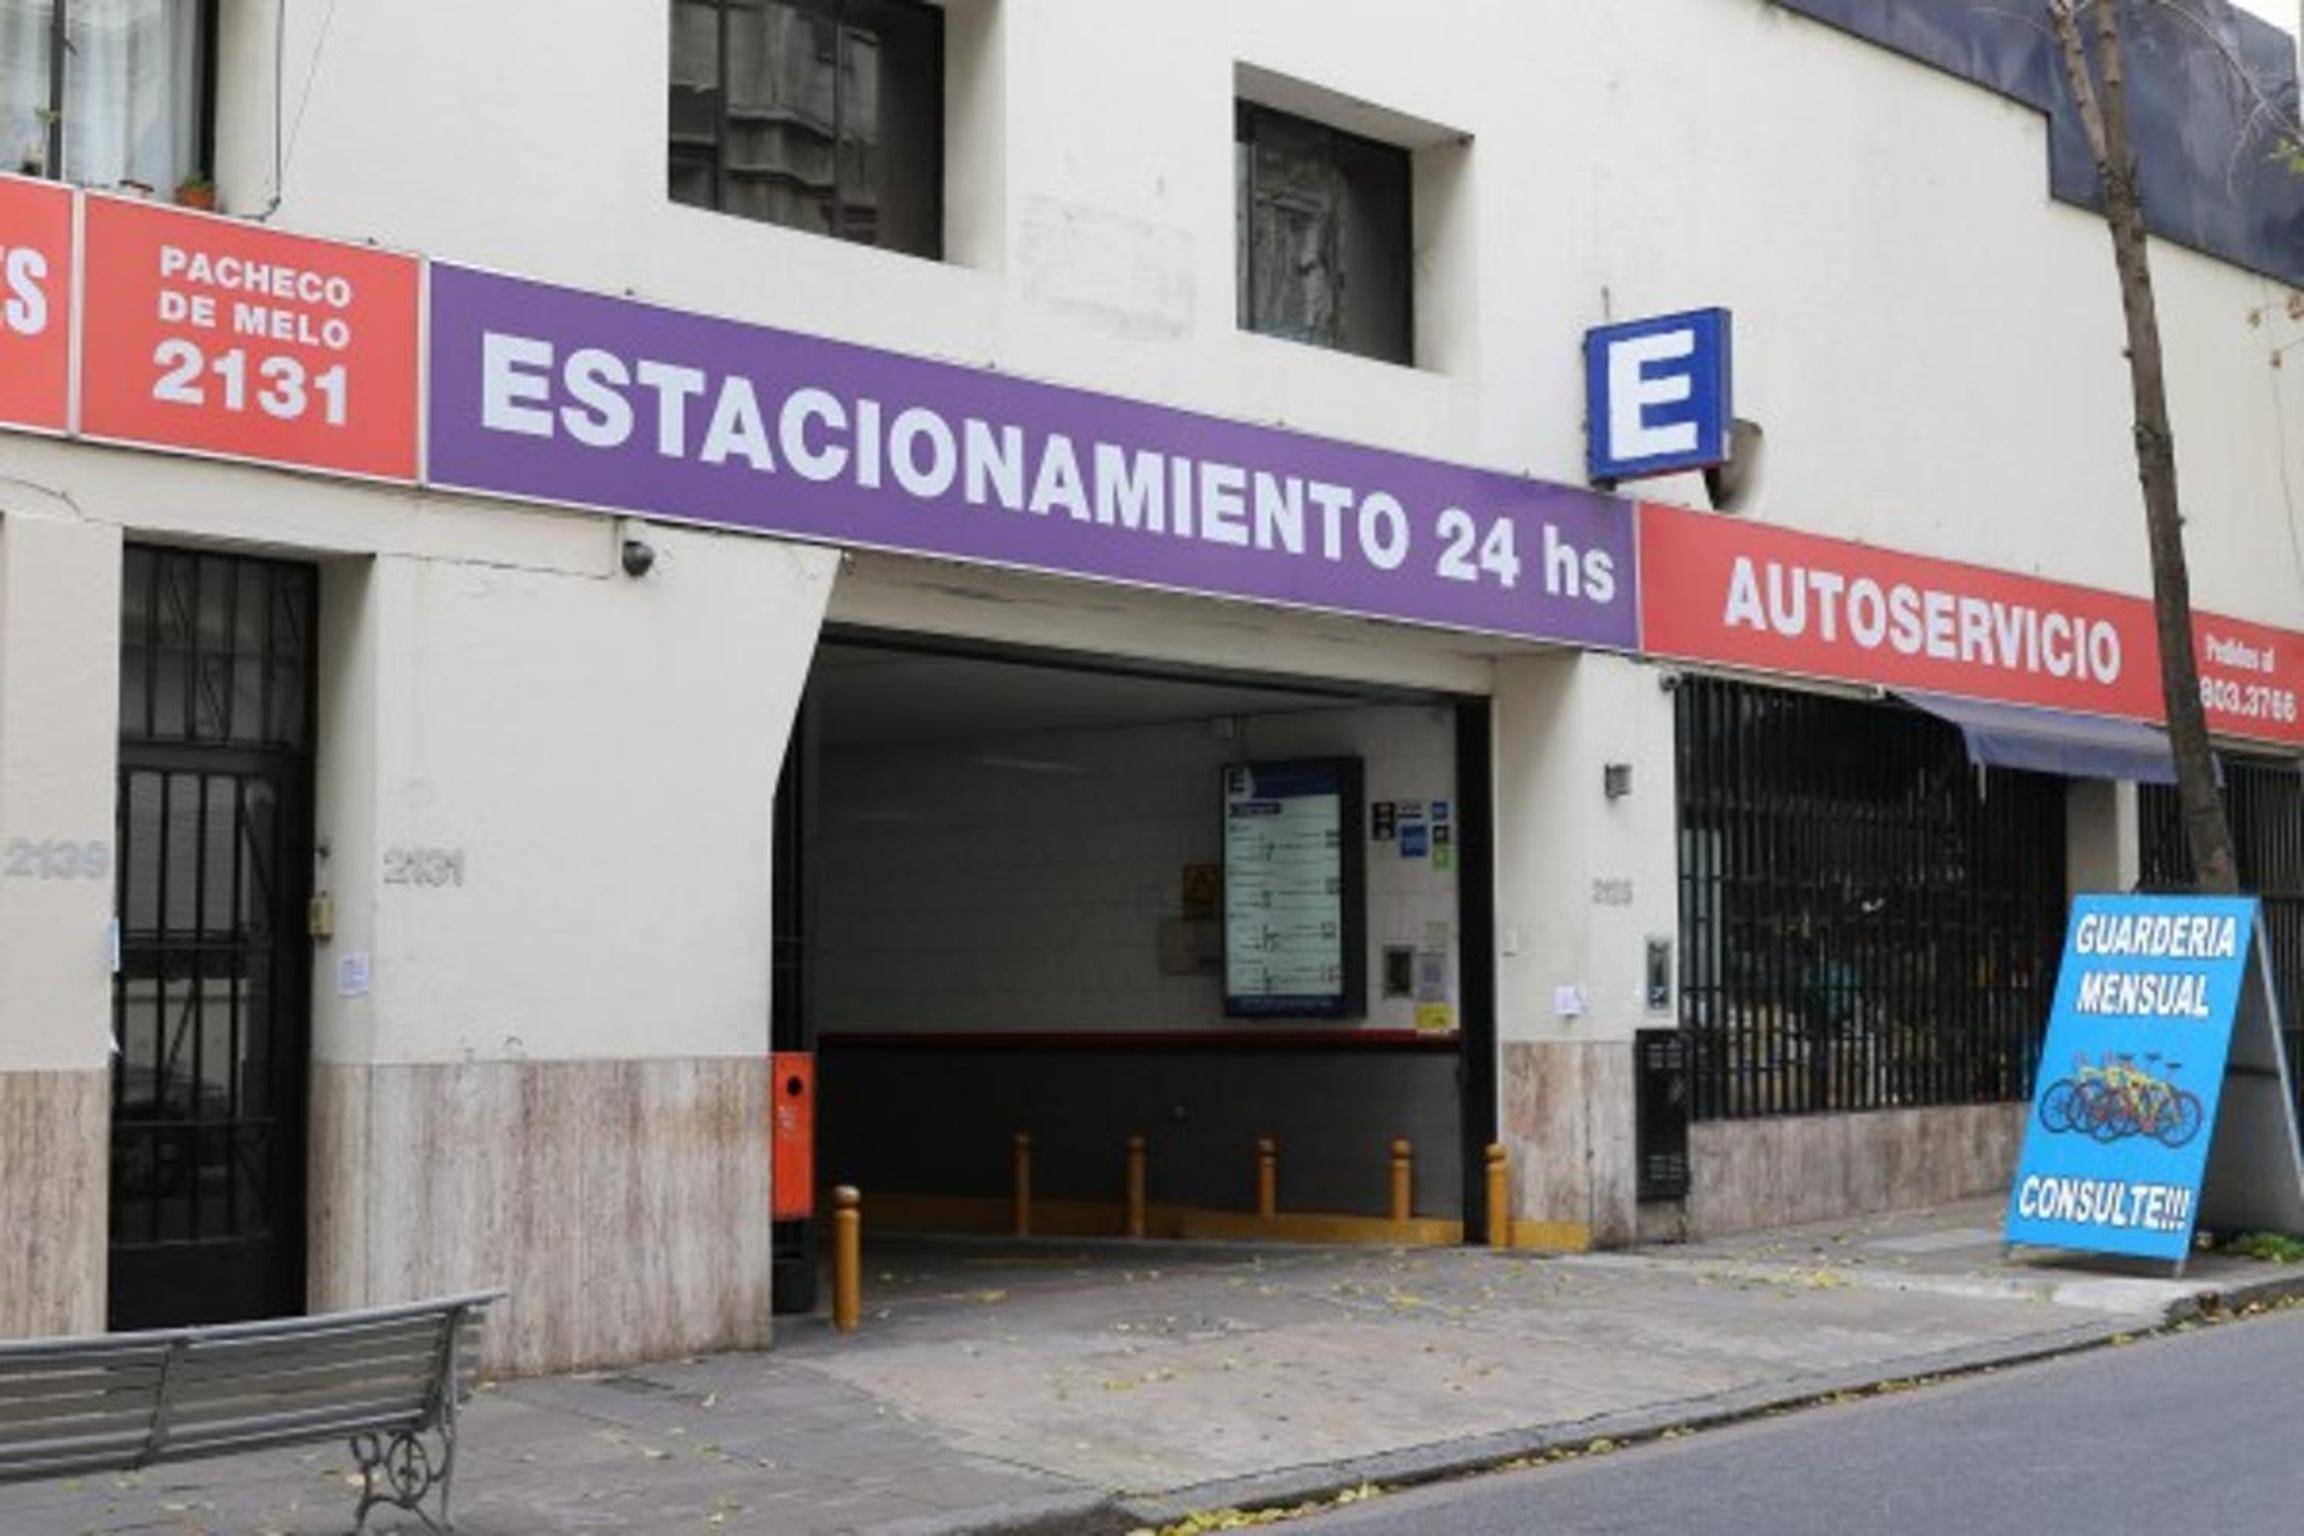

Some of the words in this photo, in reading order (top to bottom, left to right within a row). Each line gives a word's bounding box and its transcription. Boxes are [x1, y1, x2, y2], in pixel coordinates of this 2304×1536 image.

[0, 246, 48, 336] S
[160, 246, 352, 308] PACHECO
[159, 290, 216, 328] DE
[233, 303, 350, 350] MELO
[152, 338, 347, 426] 2131
[1607, 329, 1698, 460] E
[482, 332, 1410, 570] ESTACIONAMIENTO
[1436, 508, 1521, 588] 24
[1543, 525, 1616, 604] hs
[1724, 556, 2122, 685] AUTOSERVICIO
[2075, 913, 2236, 958] GUARDERIA
[2077, 971, 2209, 1017] MENSUAL
[2018, 1175, 2190, 1231] CONSULTE!!!
